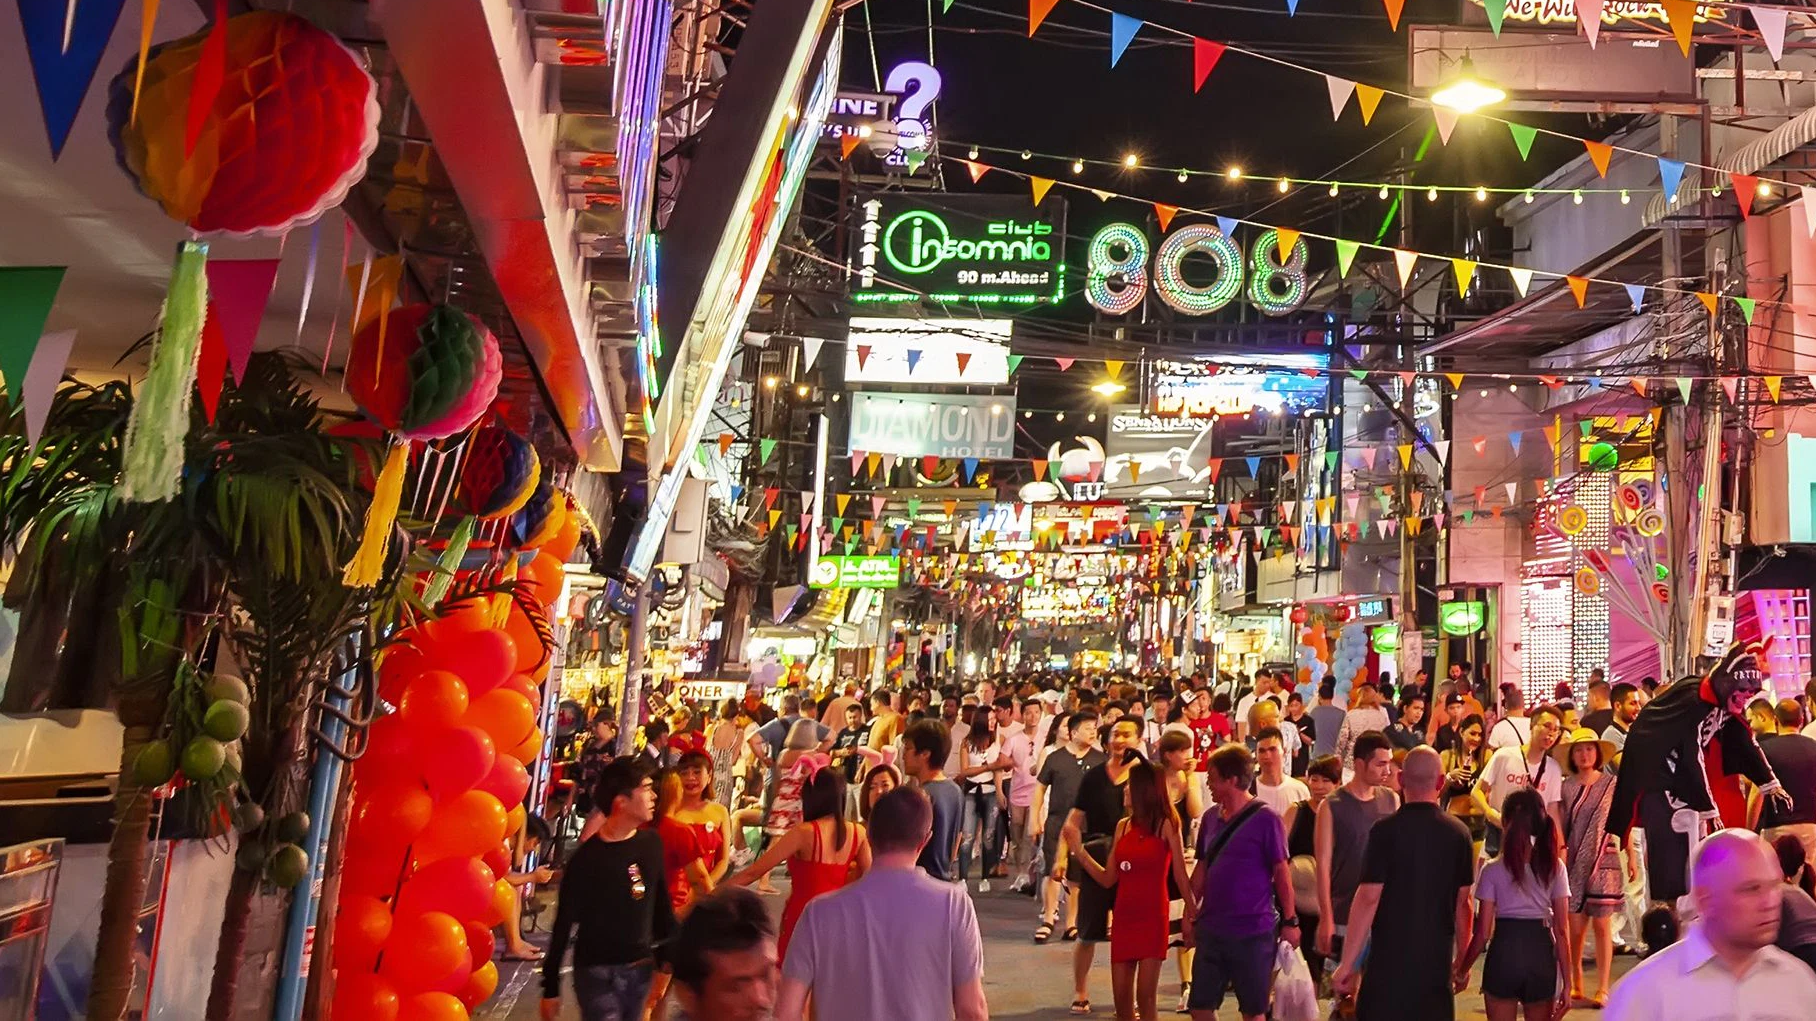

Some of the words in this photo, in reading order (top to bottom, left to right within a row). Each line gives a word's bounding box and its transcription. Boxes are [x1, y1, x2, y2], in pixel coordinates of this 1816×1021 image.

[957, 270, 979, 284] 90
[1086, 222, 1309, 316] 808
[853, 404, 1014, 444] DIAMOND
[942, 445, 1007, 460] HOTEL
